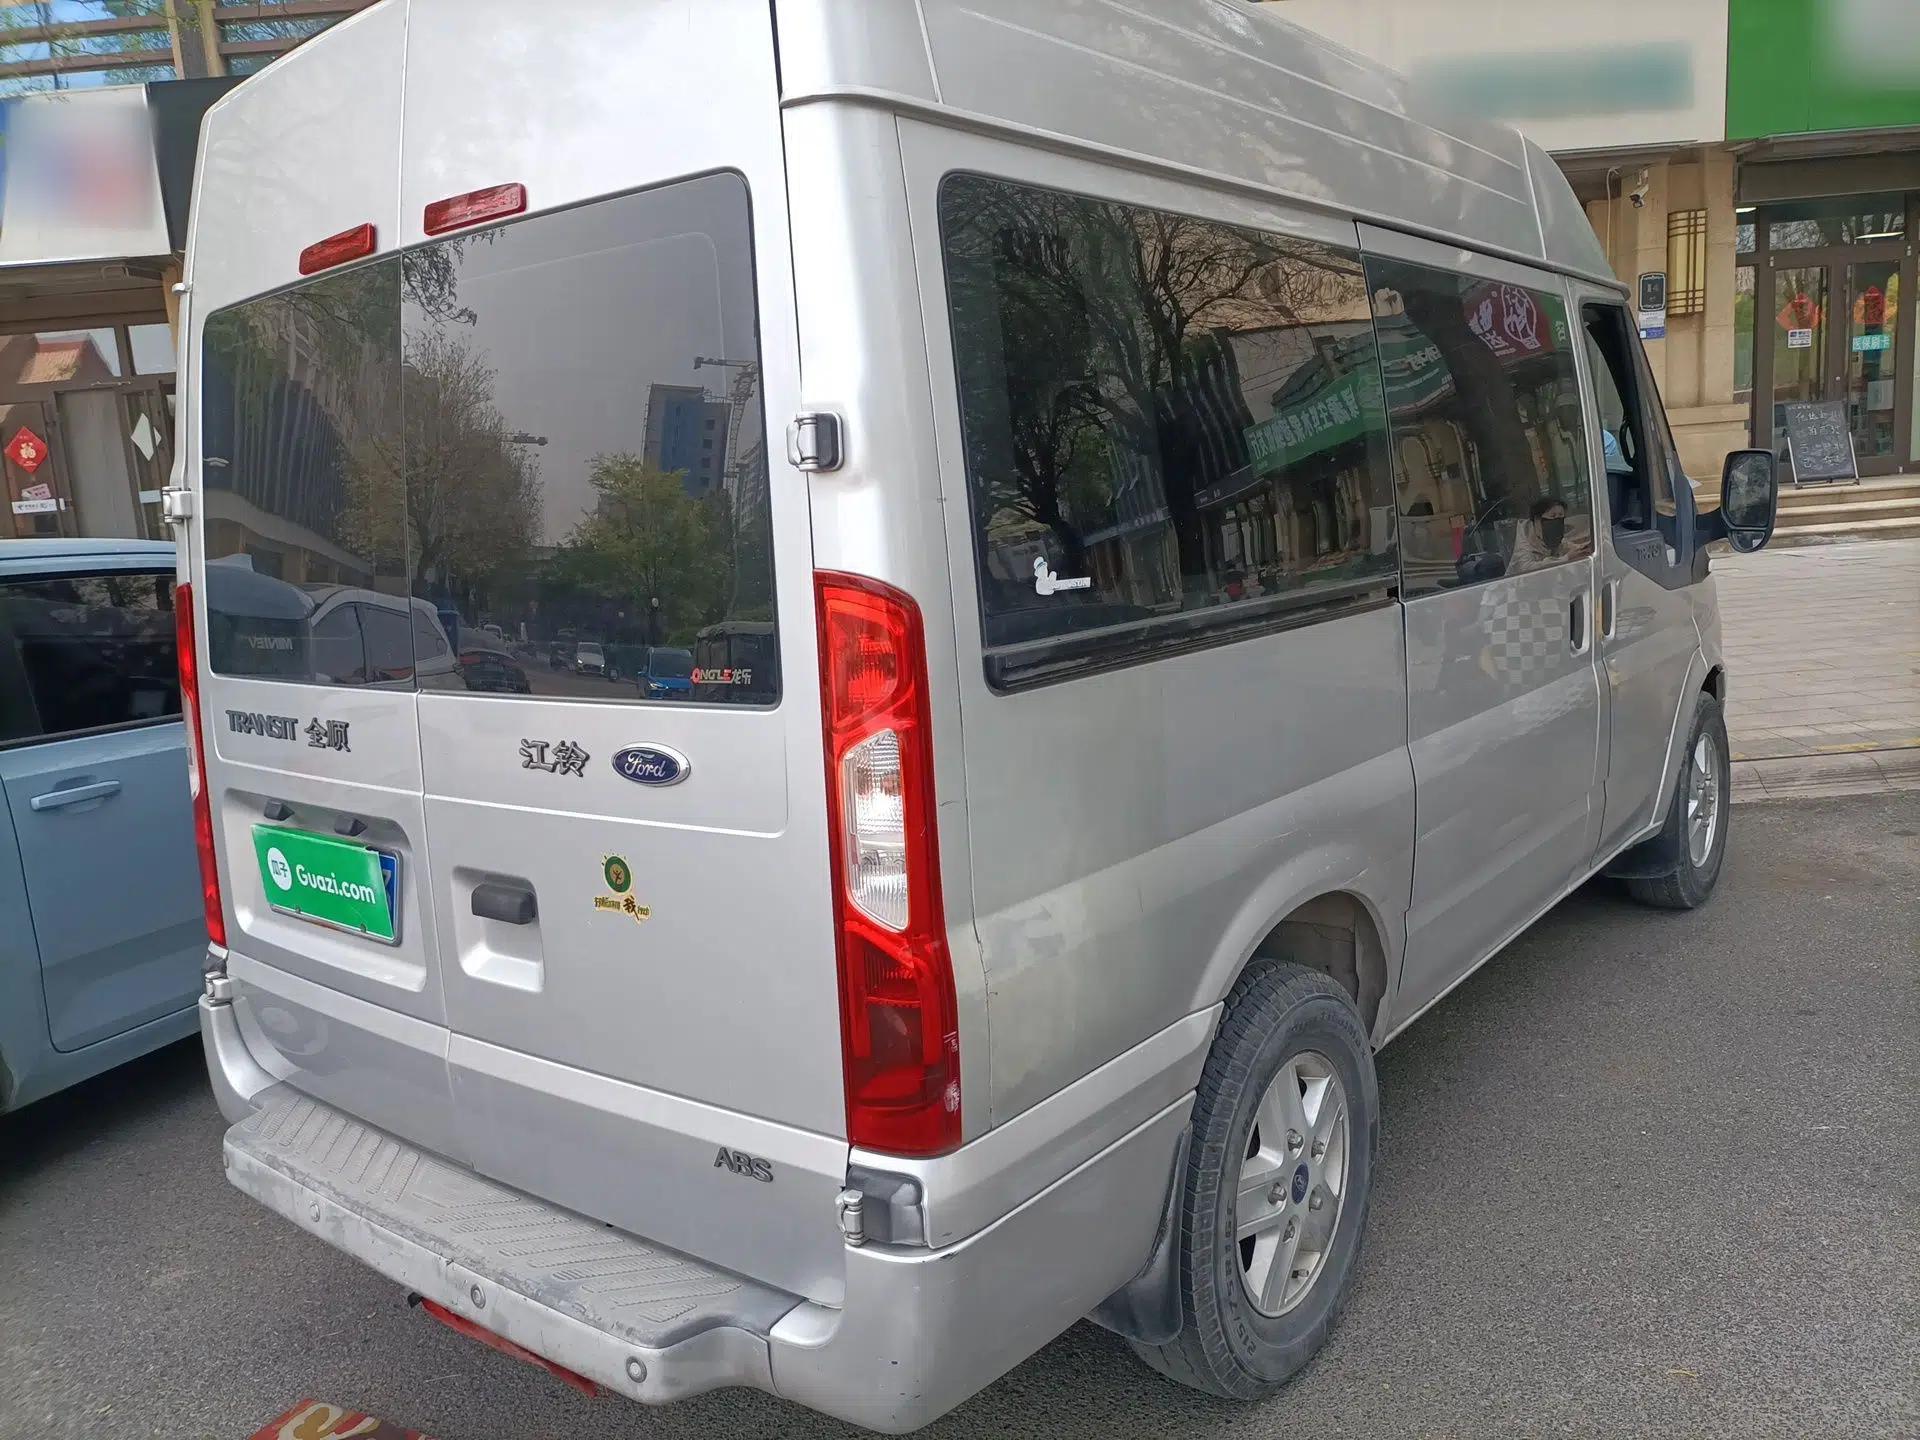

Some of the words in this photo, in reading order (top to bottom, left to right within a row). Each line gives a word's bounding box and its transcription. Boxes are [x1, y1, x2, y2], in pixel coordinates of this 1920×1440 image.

[225, 710, 298, 741] TRANSIT
[304, 717, 351, 752] 全顺
[519, 738, 590, 778] 江铃
[624, 751, 666, 778] Ford
[296, 864, 376, 904] Guazi.com
[714, 1147, 773, 1183] ABS
